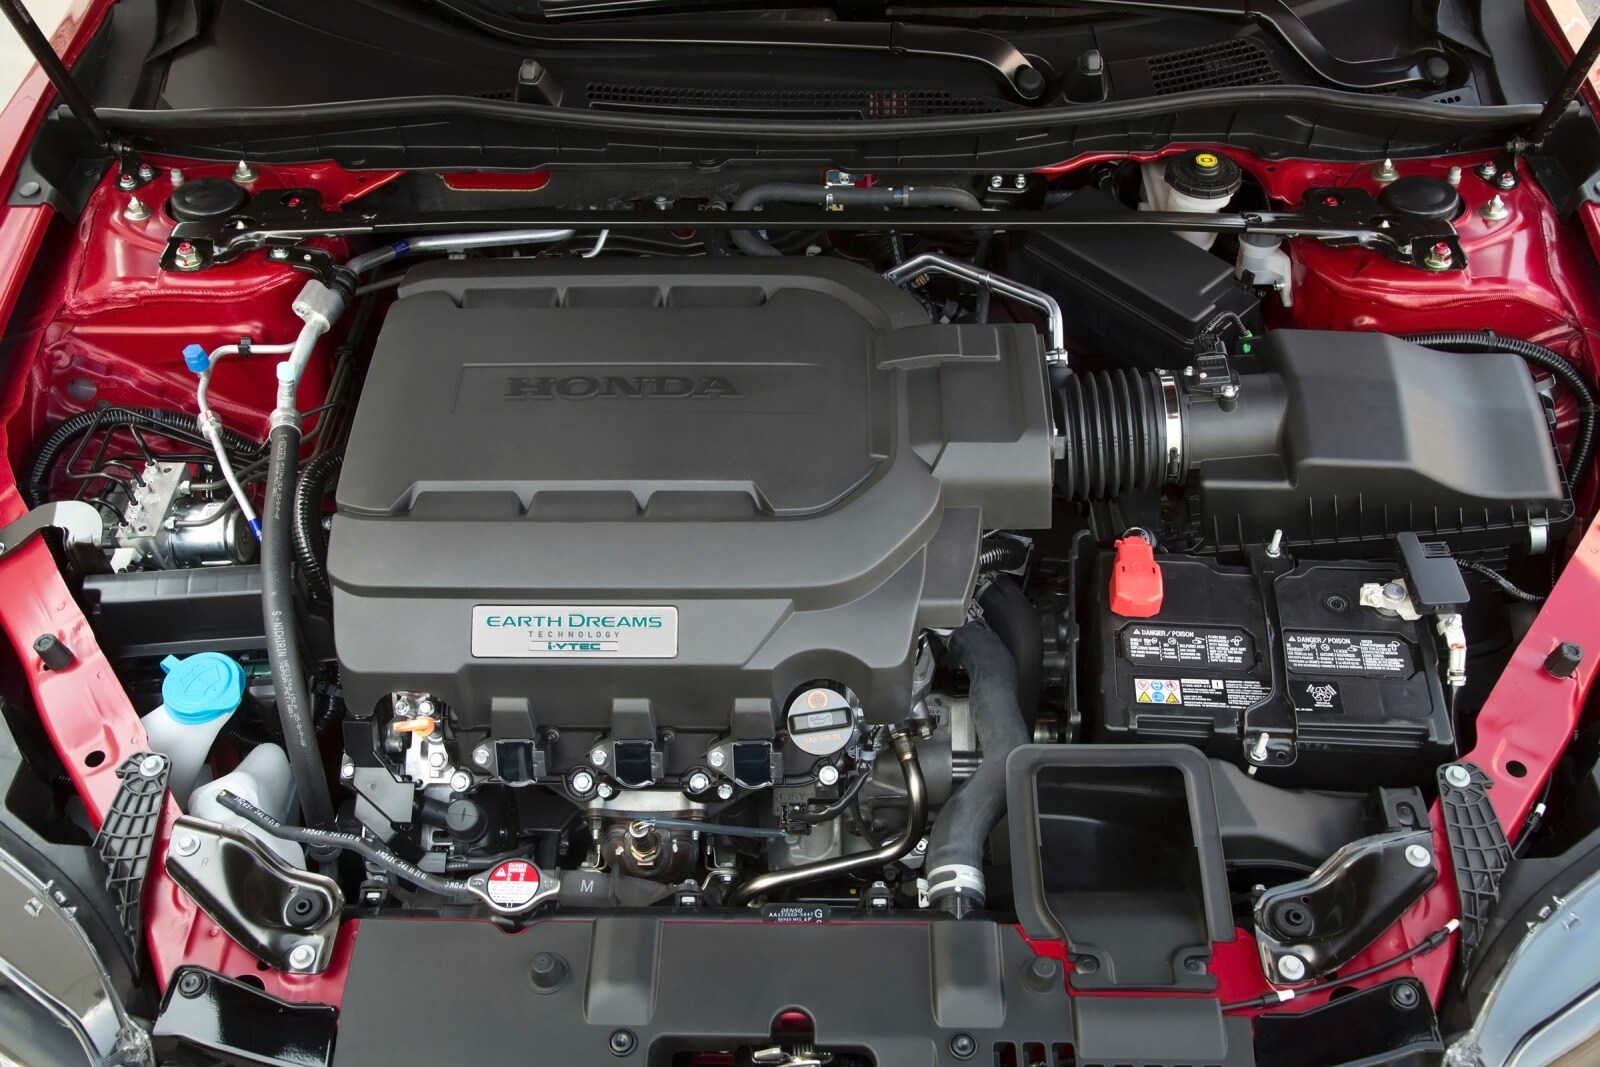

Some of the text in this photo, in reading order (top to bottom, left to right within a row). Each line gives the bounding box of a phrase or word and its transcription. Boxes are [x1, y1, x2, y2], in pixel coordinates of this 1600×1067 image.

[504, 376, 744, 400] HONDA
[486, 613, 663, 628] EARTH DREAMS
[1171, 630, 1194, 638] POISON
[580, 879, 594, 893] M
